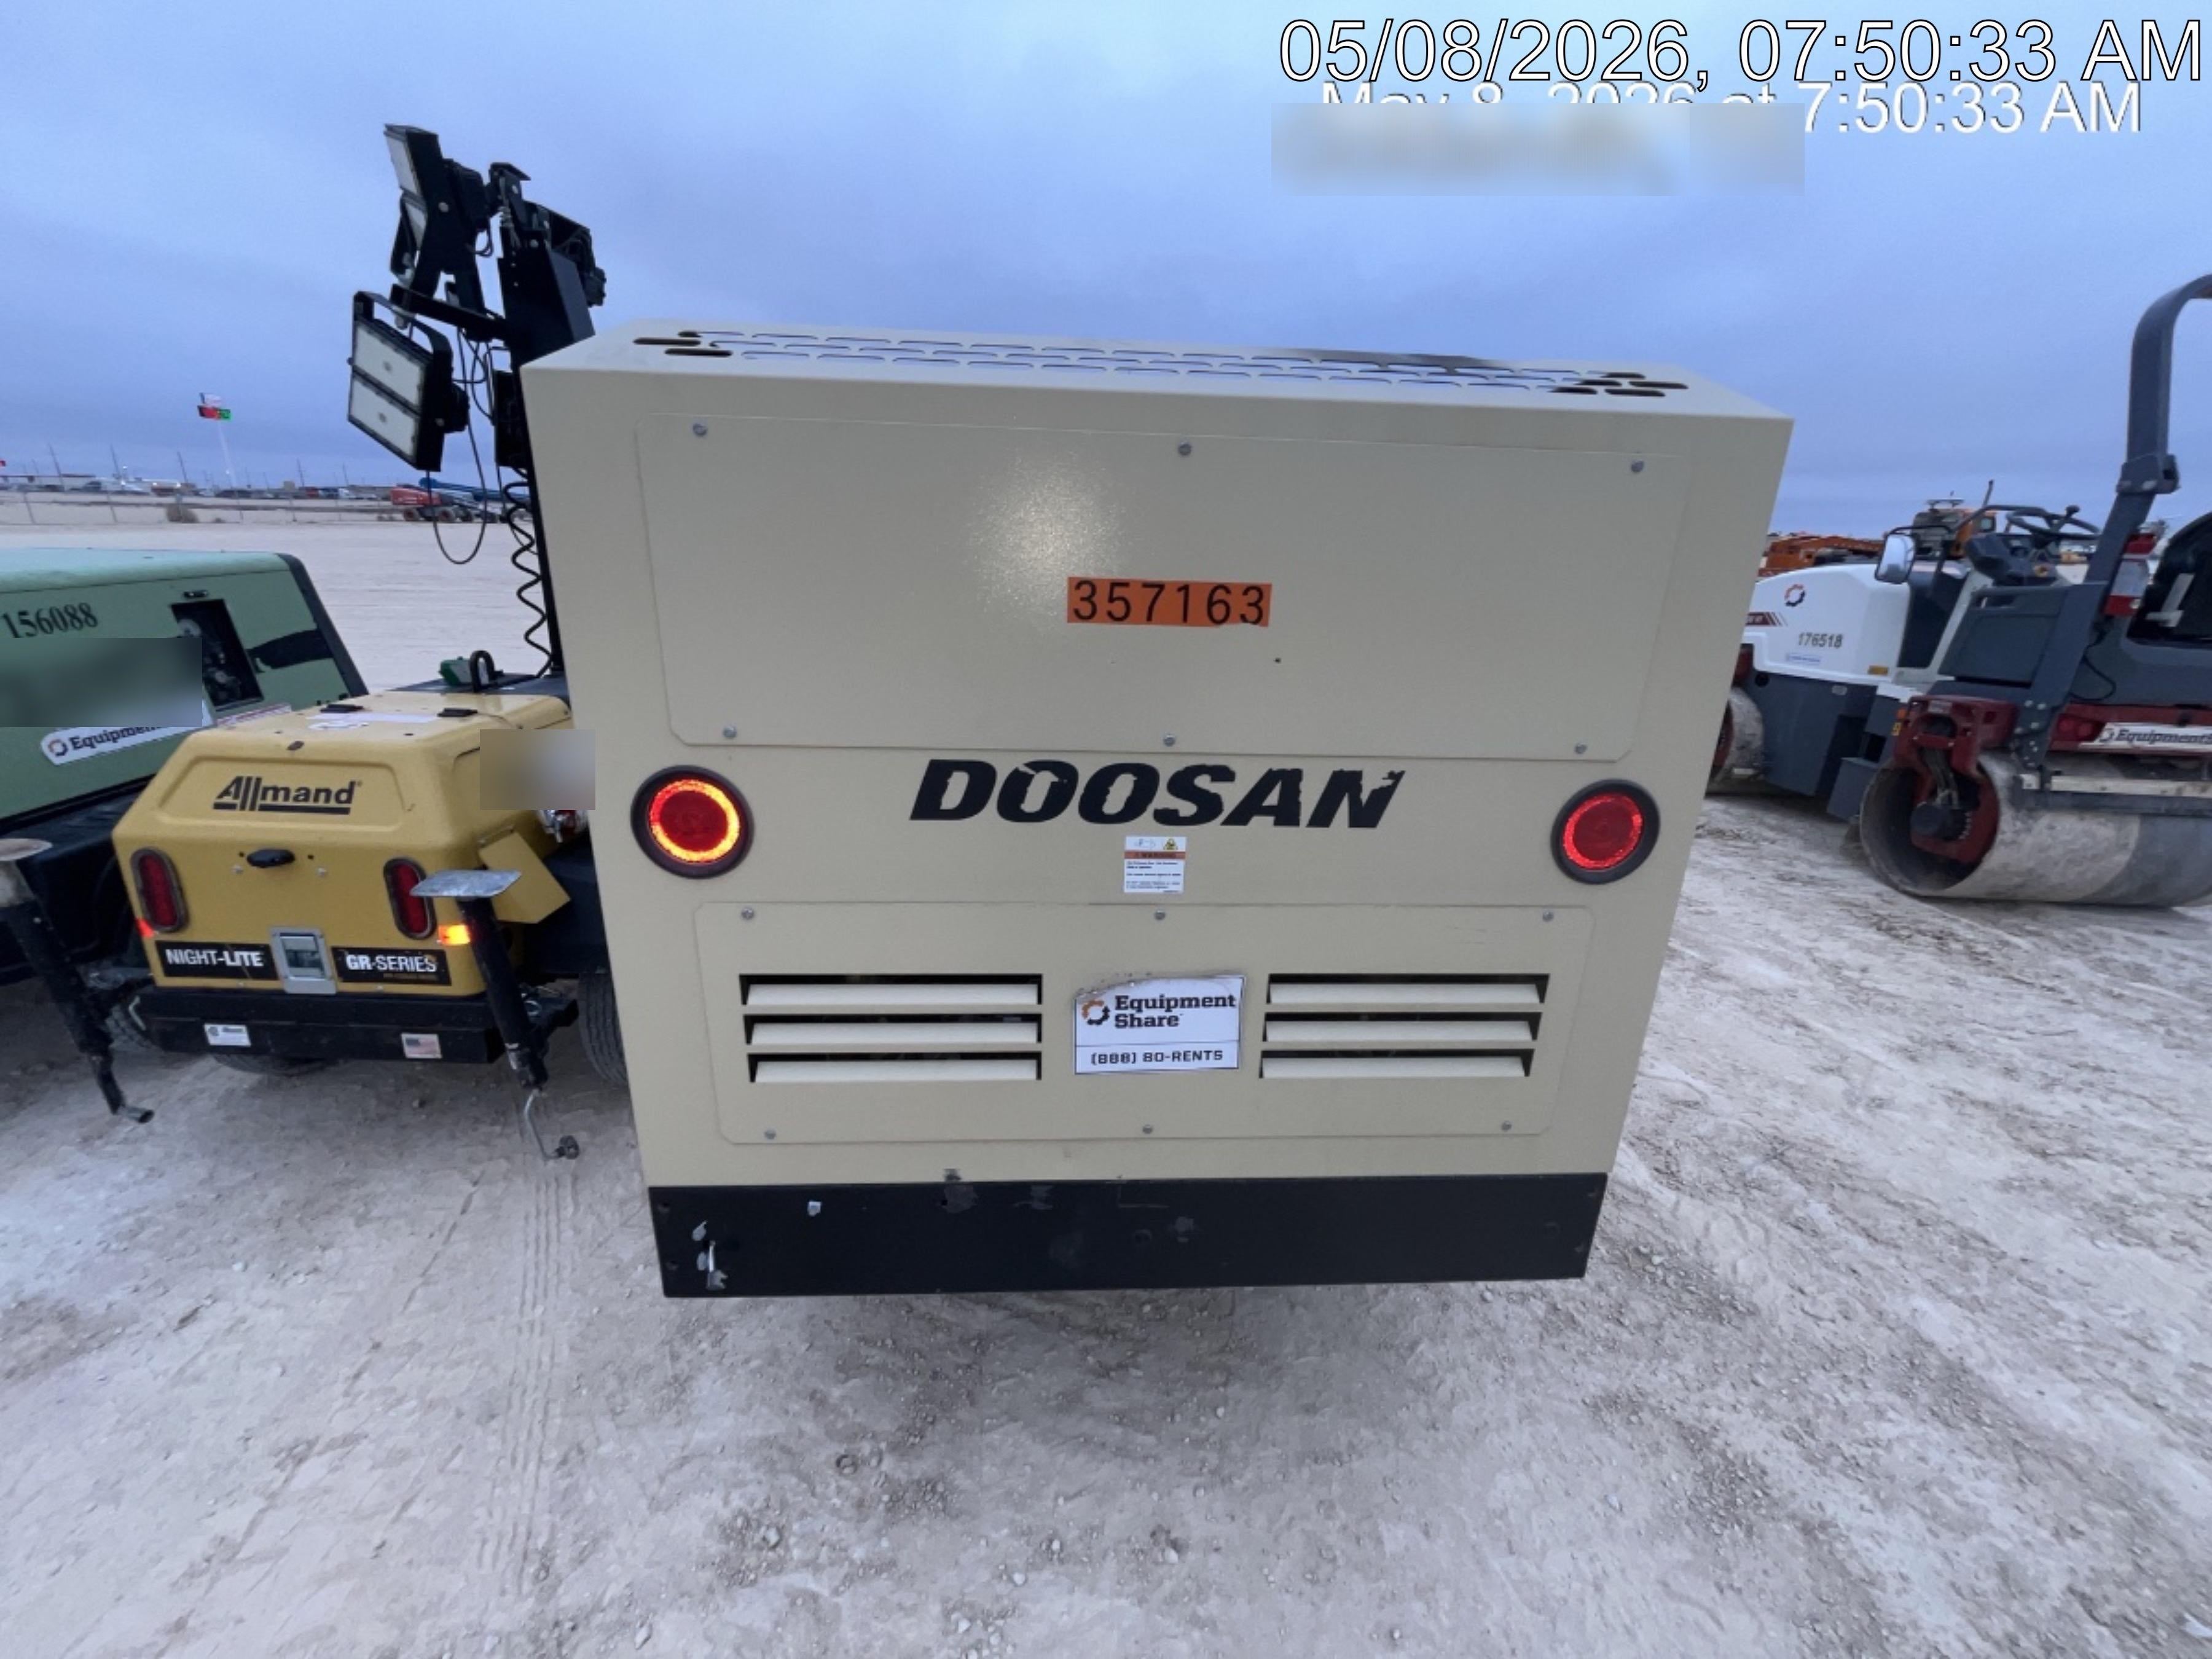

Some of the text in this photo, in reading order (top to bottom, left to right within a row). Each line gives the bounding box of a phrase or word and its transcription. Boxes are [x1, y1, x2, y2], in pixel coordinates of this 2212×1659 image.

[1073, 579, 1265, 626] 357163
[2, 602, 98, 638] 156088
[1798, 632, 1843, 648] 176518
[213, 775, 357, 811] Allmand
[909, 758, 1406, 828] DOOSAN
[165, 948, 264, 967] NIGHT-LITE
[345, 954, 438, 973] GR-SERIES
[1114, 994, 1237, 1013] Equipment
[1114, 1014, 1180, 1029] Share
[1091, 1049, 1223, 1065] (888) 80-RENTS
